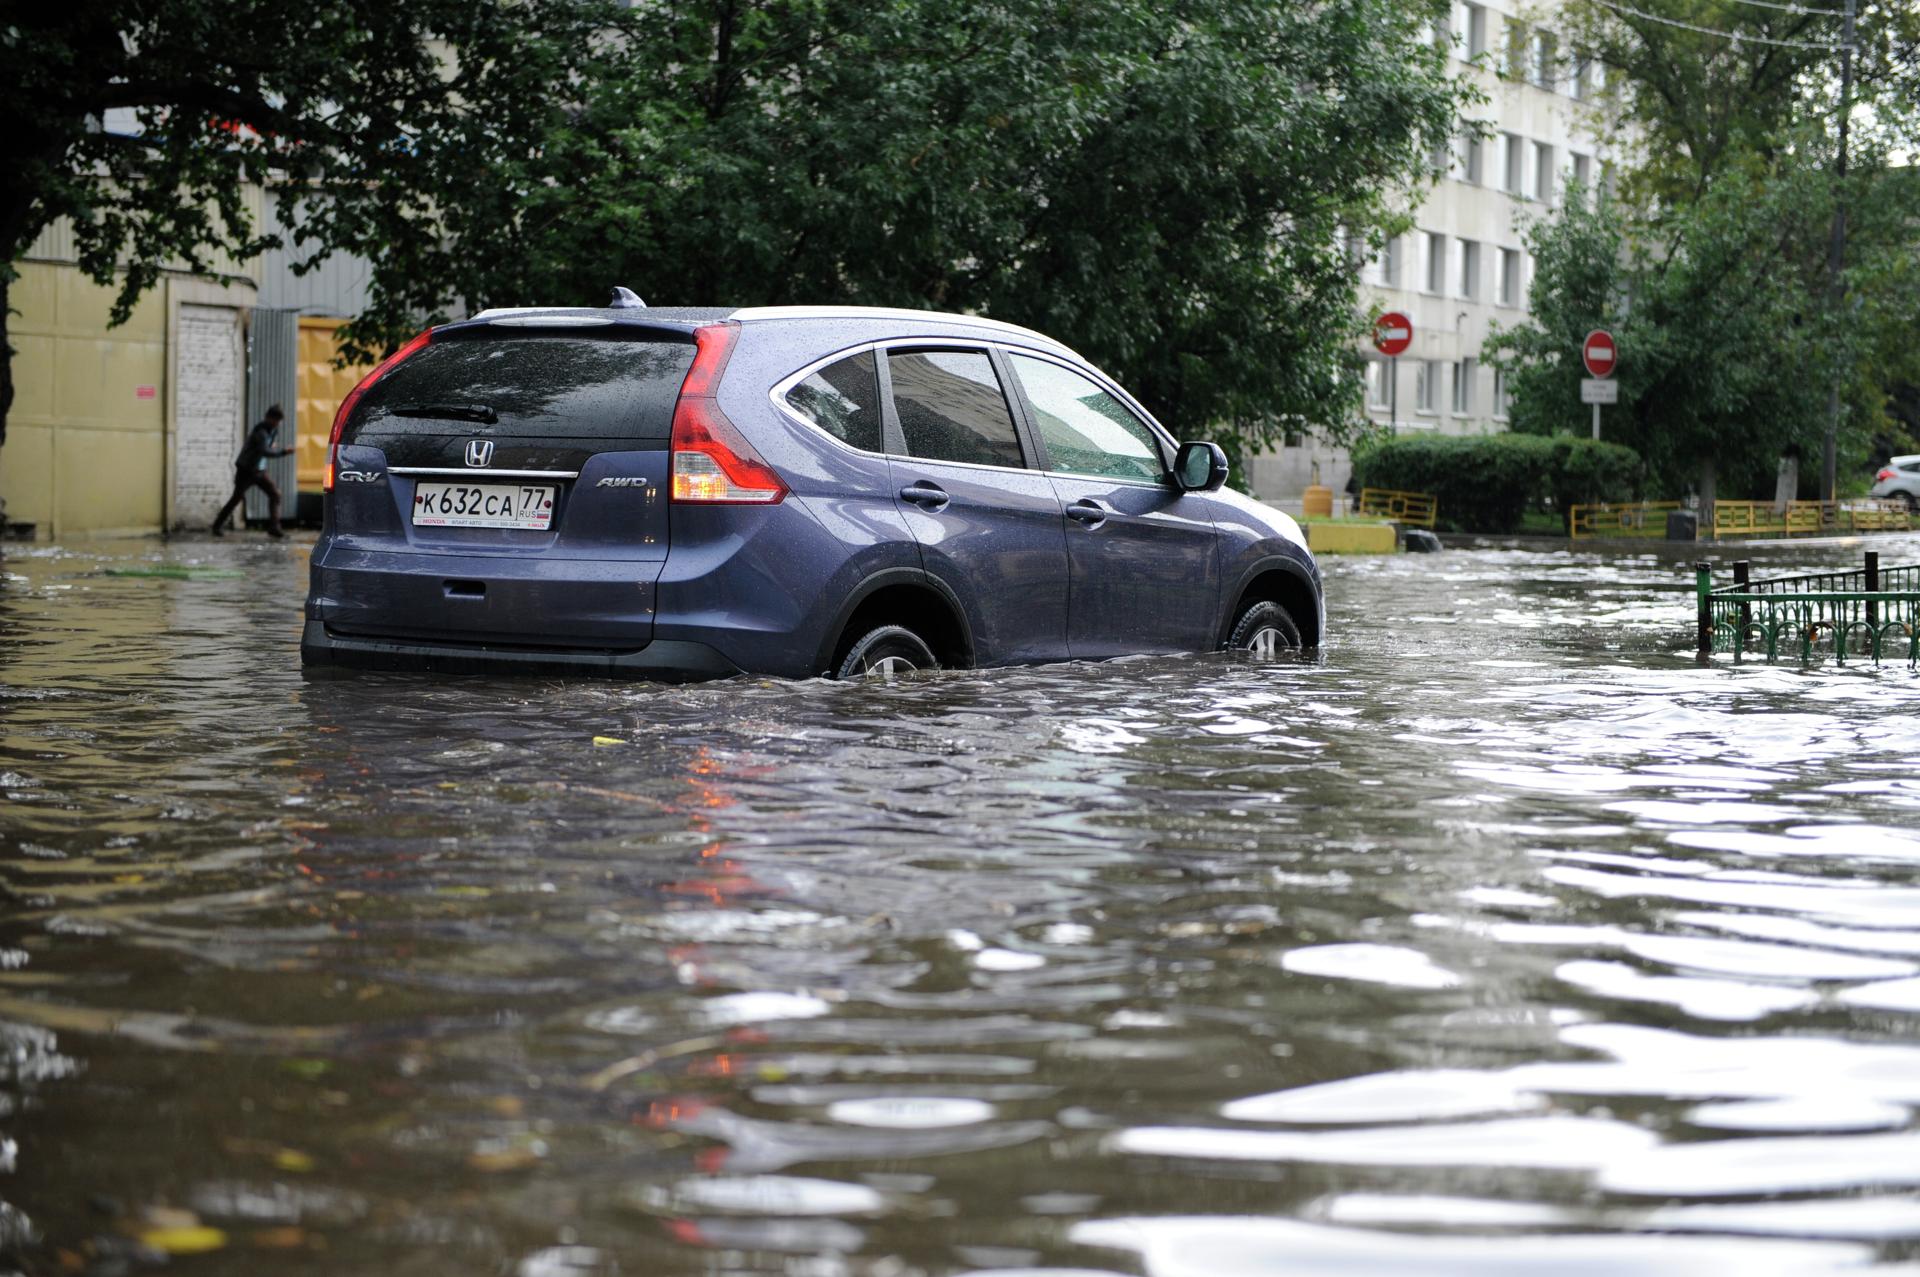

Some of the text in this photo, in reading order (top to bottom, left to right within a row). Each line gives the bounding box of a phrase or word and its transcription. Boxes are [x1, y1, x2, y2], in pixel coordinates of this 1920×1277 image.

[338, 471, 382, 482] CR-V
[596, 477, 647, 488] AWD
[423, 487, 546, 516] К632СА 77
[519, 510, 537, 519] RUS
